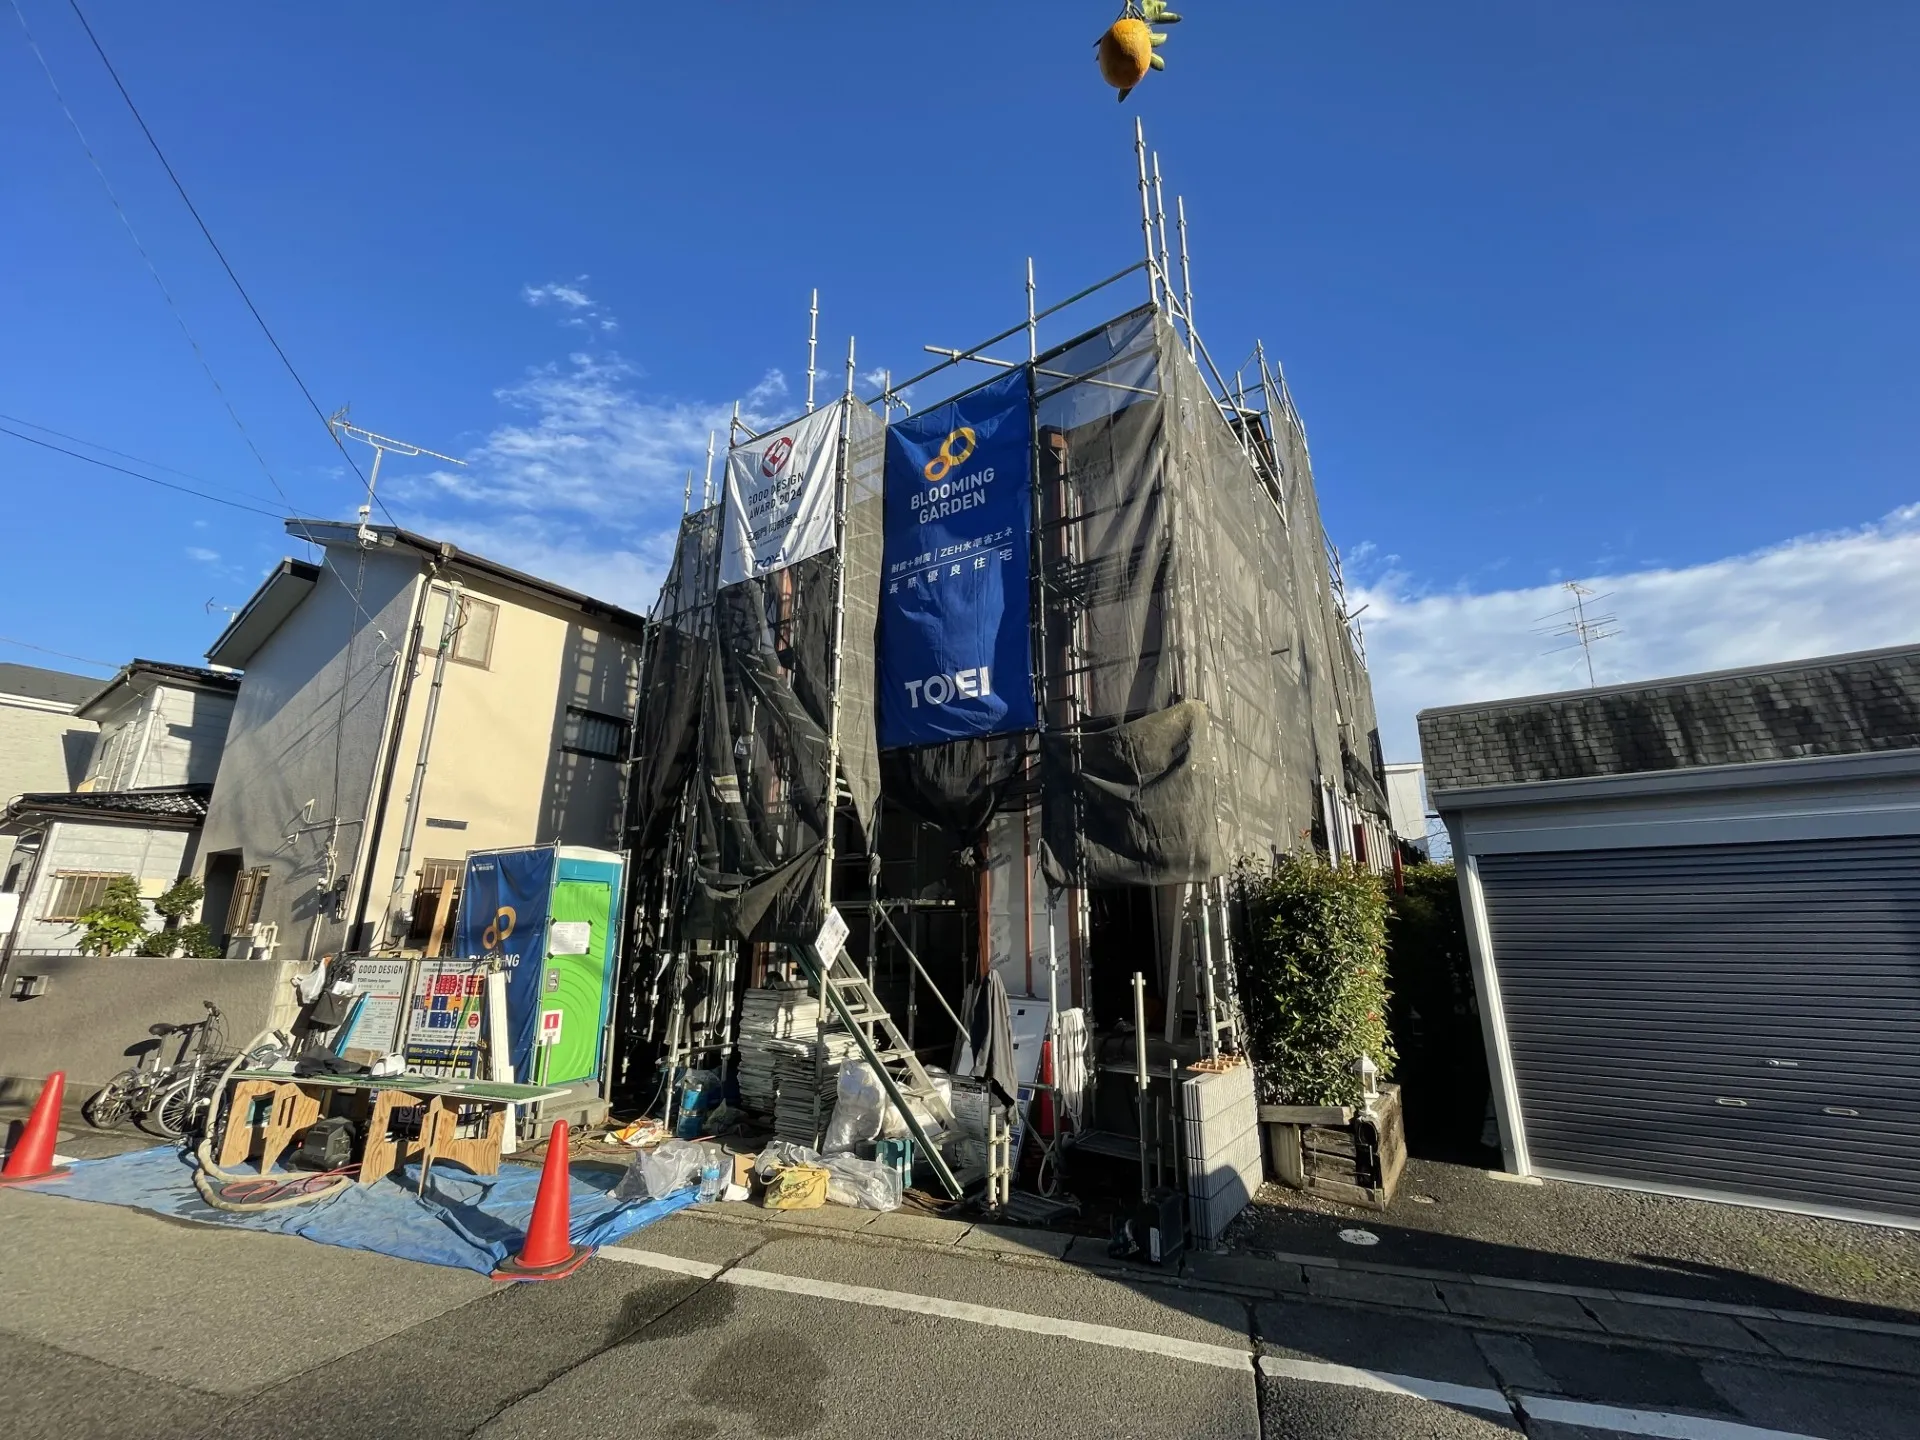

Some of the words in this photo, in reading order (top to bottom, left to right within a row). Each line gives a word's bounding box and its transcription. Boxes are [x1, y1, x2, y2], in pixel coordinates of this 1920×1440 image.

[748, 488, 769, 507] GOOD
[770, 471, 804, 495] DESIGN
[749, 498, 776, 521] AWARD
[779, 485, 803, 506] 2024
[910, 467, 995, 510] BLOOMING
[919, 488, 986, 524] GARDEN
[889, 548, 1013, 595] 長期優良住宅
[904, 666, 990, 708] TOEI
[358, 964, 377, 974] GOOD
[378, 964, 404, 975] DESIGN
